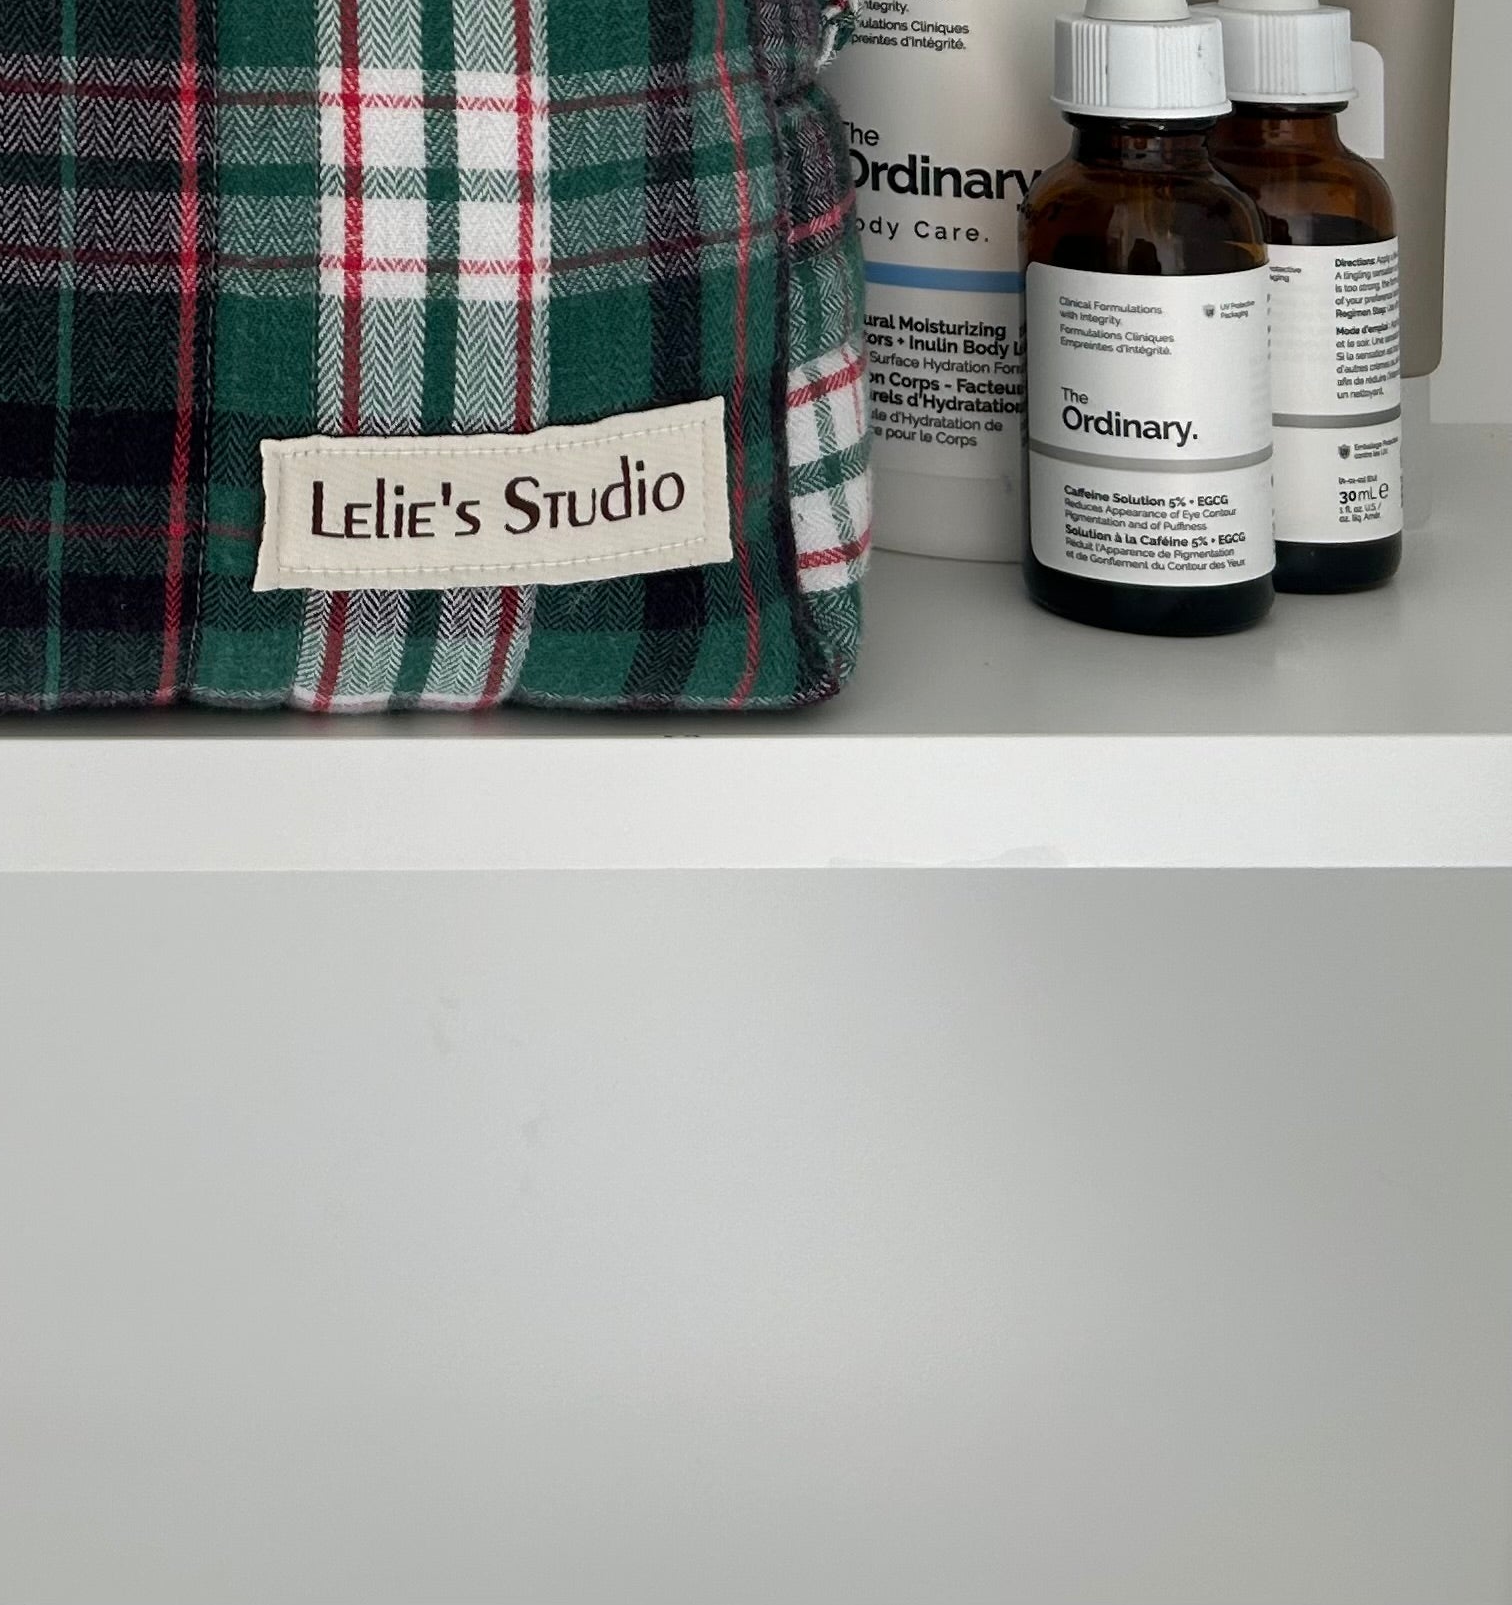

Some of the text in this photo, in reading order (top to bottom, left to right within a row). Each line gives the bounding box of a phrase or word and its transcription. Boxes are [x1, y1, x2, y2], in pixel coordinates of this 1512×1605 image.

[911, 20, 970, 36] Cliniques
[851, 33, 967, 52] preintes d'Intégrité.
[855, 216, 989, 242] ody Care.
[1344, 283, 1358, 293] too
[1059, 296, 1163, 315] Clinical Formulations
[1335, 297, 1345, 307] of
[1346, 295, 1363, 308] your
[1060, 309, 1078, 321] with
[863, 314, 1007, 342] ural Moisturizing
[1060, 324, 1175, 345] Formulations Cliniques
[909, 335, 958, 354] Inulin
[963, 340, 1009, 359] Body
[1060, 336, 1113, 353] Empreintes
[1336, 339, 1346, 349] et
[869, 350, 920, 369] Surface
[923, 356, 990, 374] Hydration
[889, 372, 940, 394] Corps
[1061, 386, 1089, 405] The
[890, 411, 981, 431] d'Hydratation
[984, 419, 1003, 432] de
[1062, 405, 1198, 448] Ordinary.
[886, 427, 917, 441] pour
[920, 429, 933, 443] le
[936, 431, 978, 448] Corps
[1064, 484, 1110, 503] Caffeine
[1112, 493, 1165, 507] Solution
[1169, 497, 1186, 508] 5%
[1197, 495, 1229, 507] EGCG
[1064, 497, 1237, 521] Reduces Appearance of Eye Contour
[1065, 509, 1207, 532] Pigmentation and of Puffiness
[1065, 524, 1112, 542] Solution
[1114, 531, 1123, 544] à
[1125, 534, 1137, 545] la
[1140, 535, 1189, 547] Caféine
[1191, 536, 1208, 548] 5%
[1218, 532, 1246, 545] EGCG
[1065, 549, 1246, 572] et de Gonflement du Contour des Yeux
[1095, 543, 1155, 559] l'Apparence
[1157, 548, 1172, 559] de
[1173, 547, 1235, 561] Pigmentation
